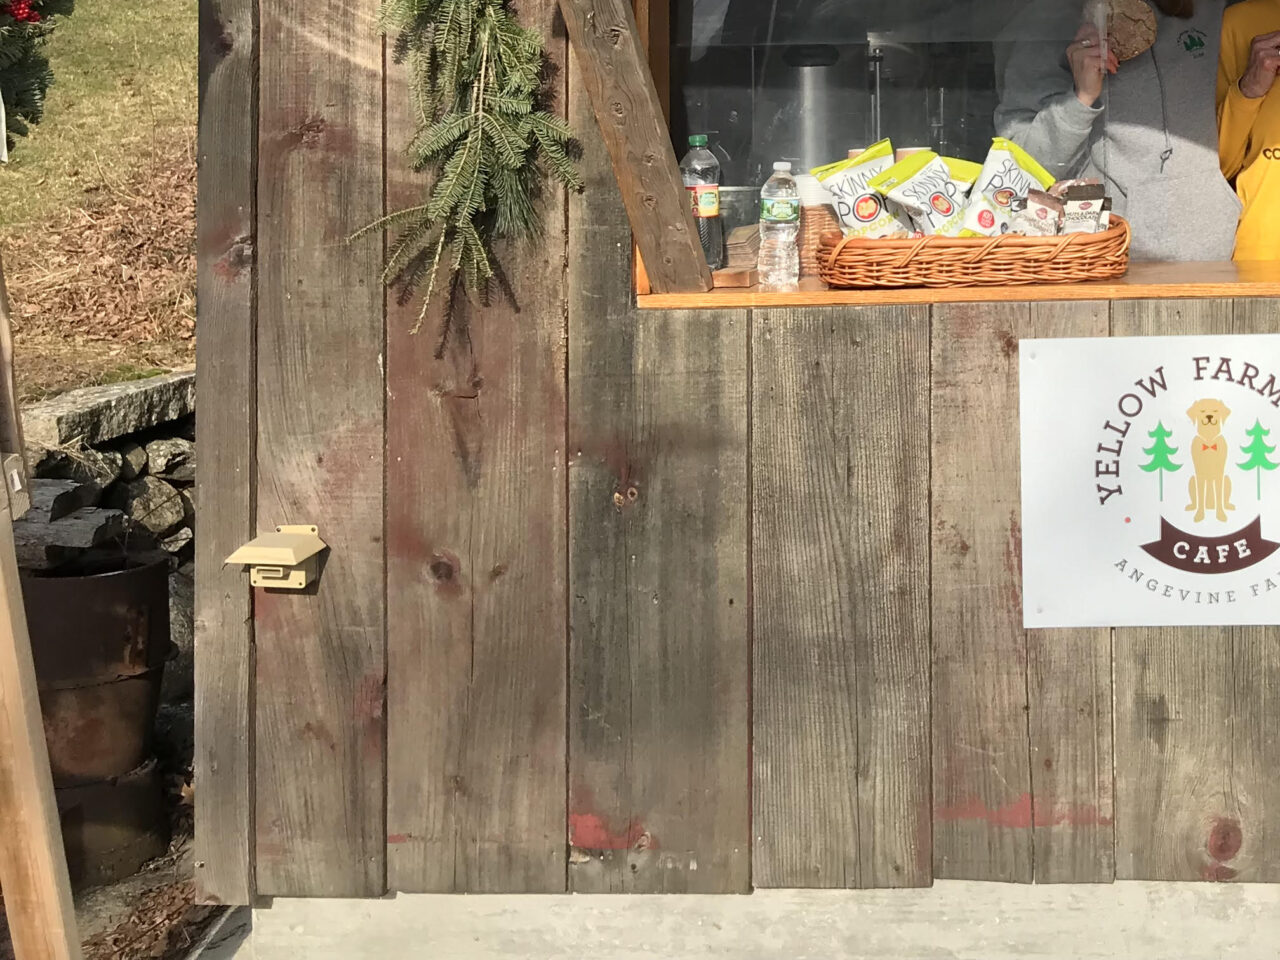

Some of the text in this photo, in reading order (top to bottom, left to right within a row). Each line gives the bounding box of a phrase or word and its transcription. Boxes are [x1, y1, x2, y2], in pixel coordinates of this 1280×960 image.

[1095, 366, 1169, 506] YELLOW
[1172, 539, 1252, 565] CAFE
[1114, 557, 1237, 605] ANGEVINE
